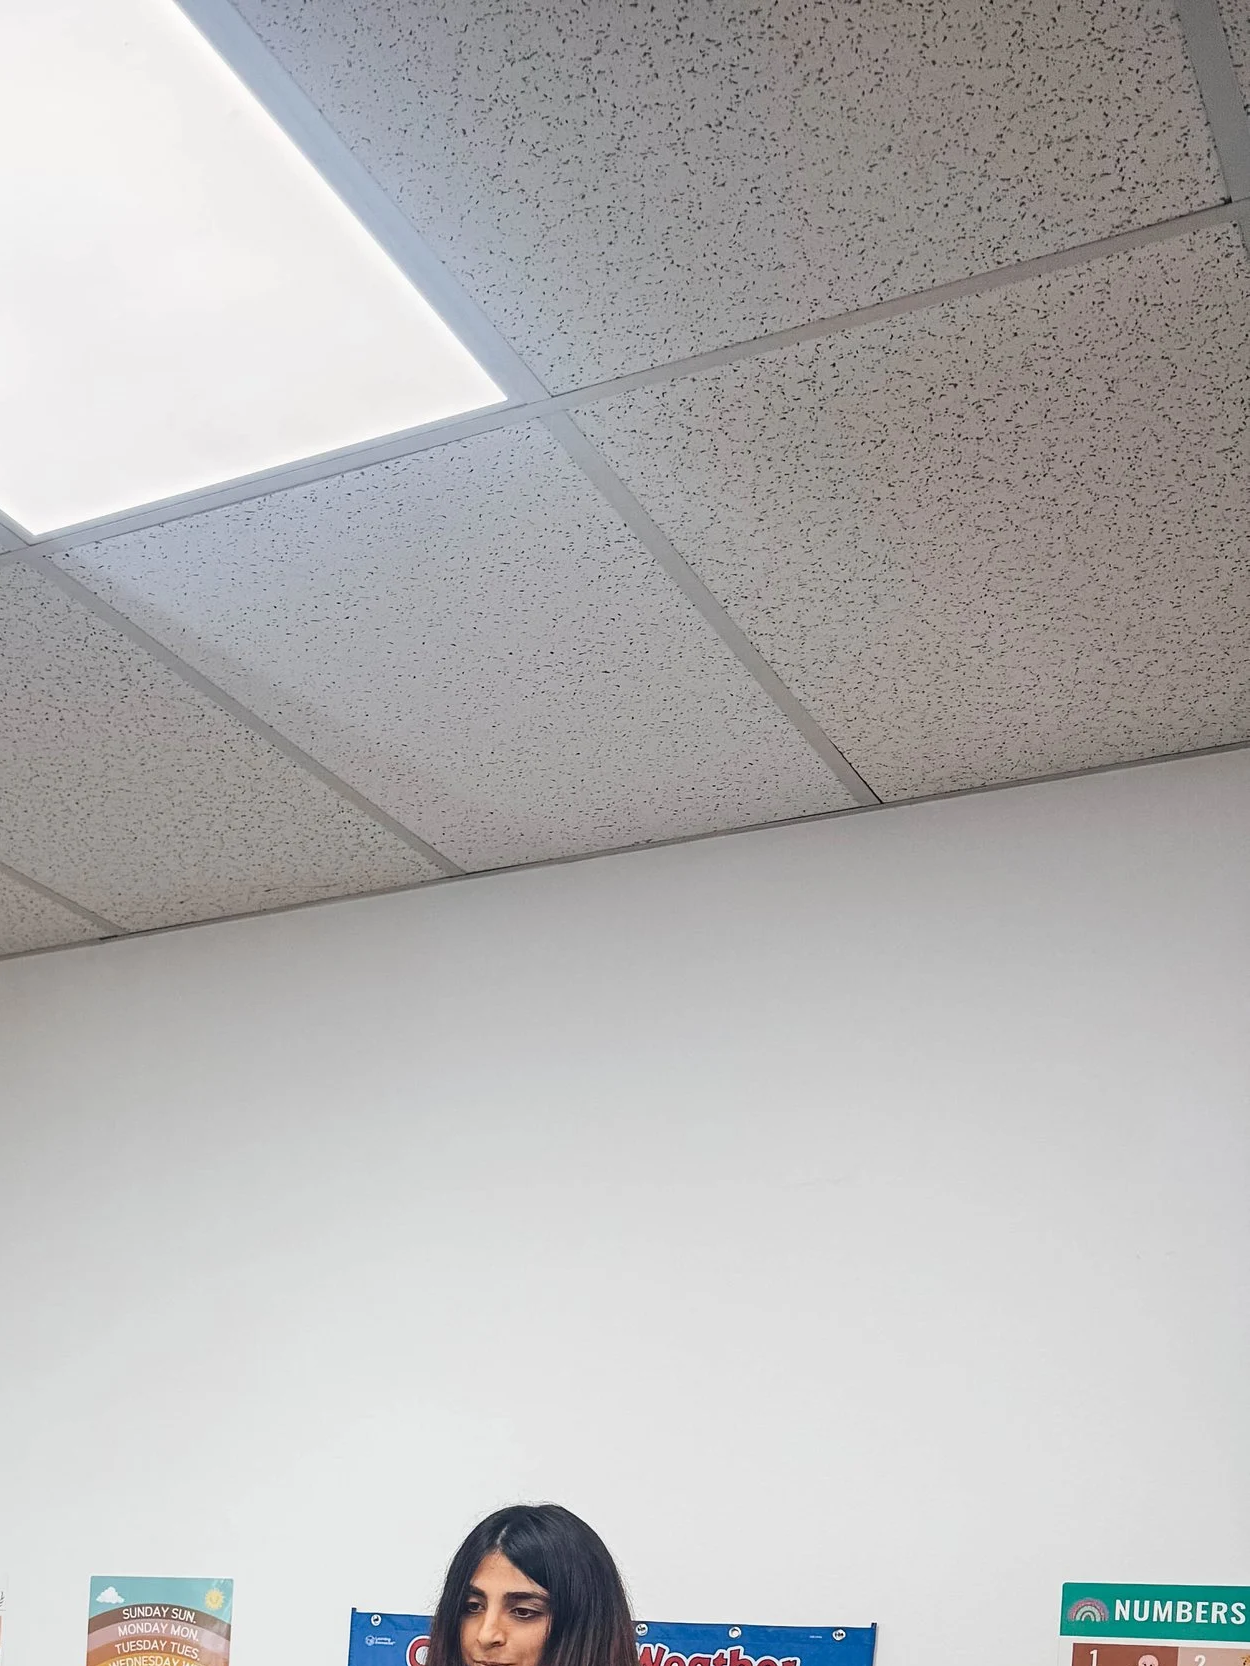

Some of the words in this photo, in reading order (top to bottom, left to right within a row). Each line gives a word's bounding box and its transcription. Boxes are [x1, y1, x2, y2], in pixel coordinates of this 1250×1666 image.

[122, 1606, 169, 1619] SUNDAY
[171, 1608, 196, 1624] SUN.
[1114, 1600, 1246, 1624] NUMBERS
[118, 1623, 168, 1636] MONDAY
[170, 1624, 199, 1641] MON.
[115, 1640, 167, 1654] TUESDAY
[170, 1642, 200, 1660] TUES.
